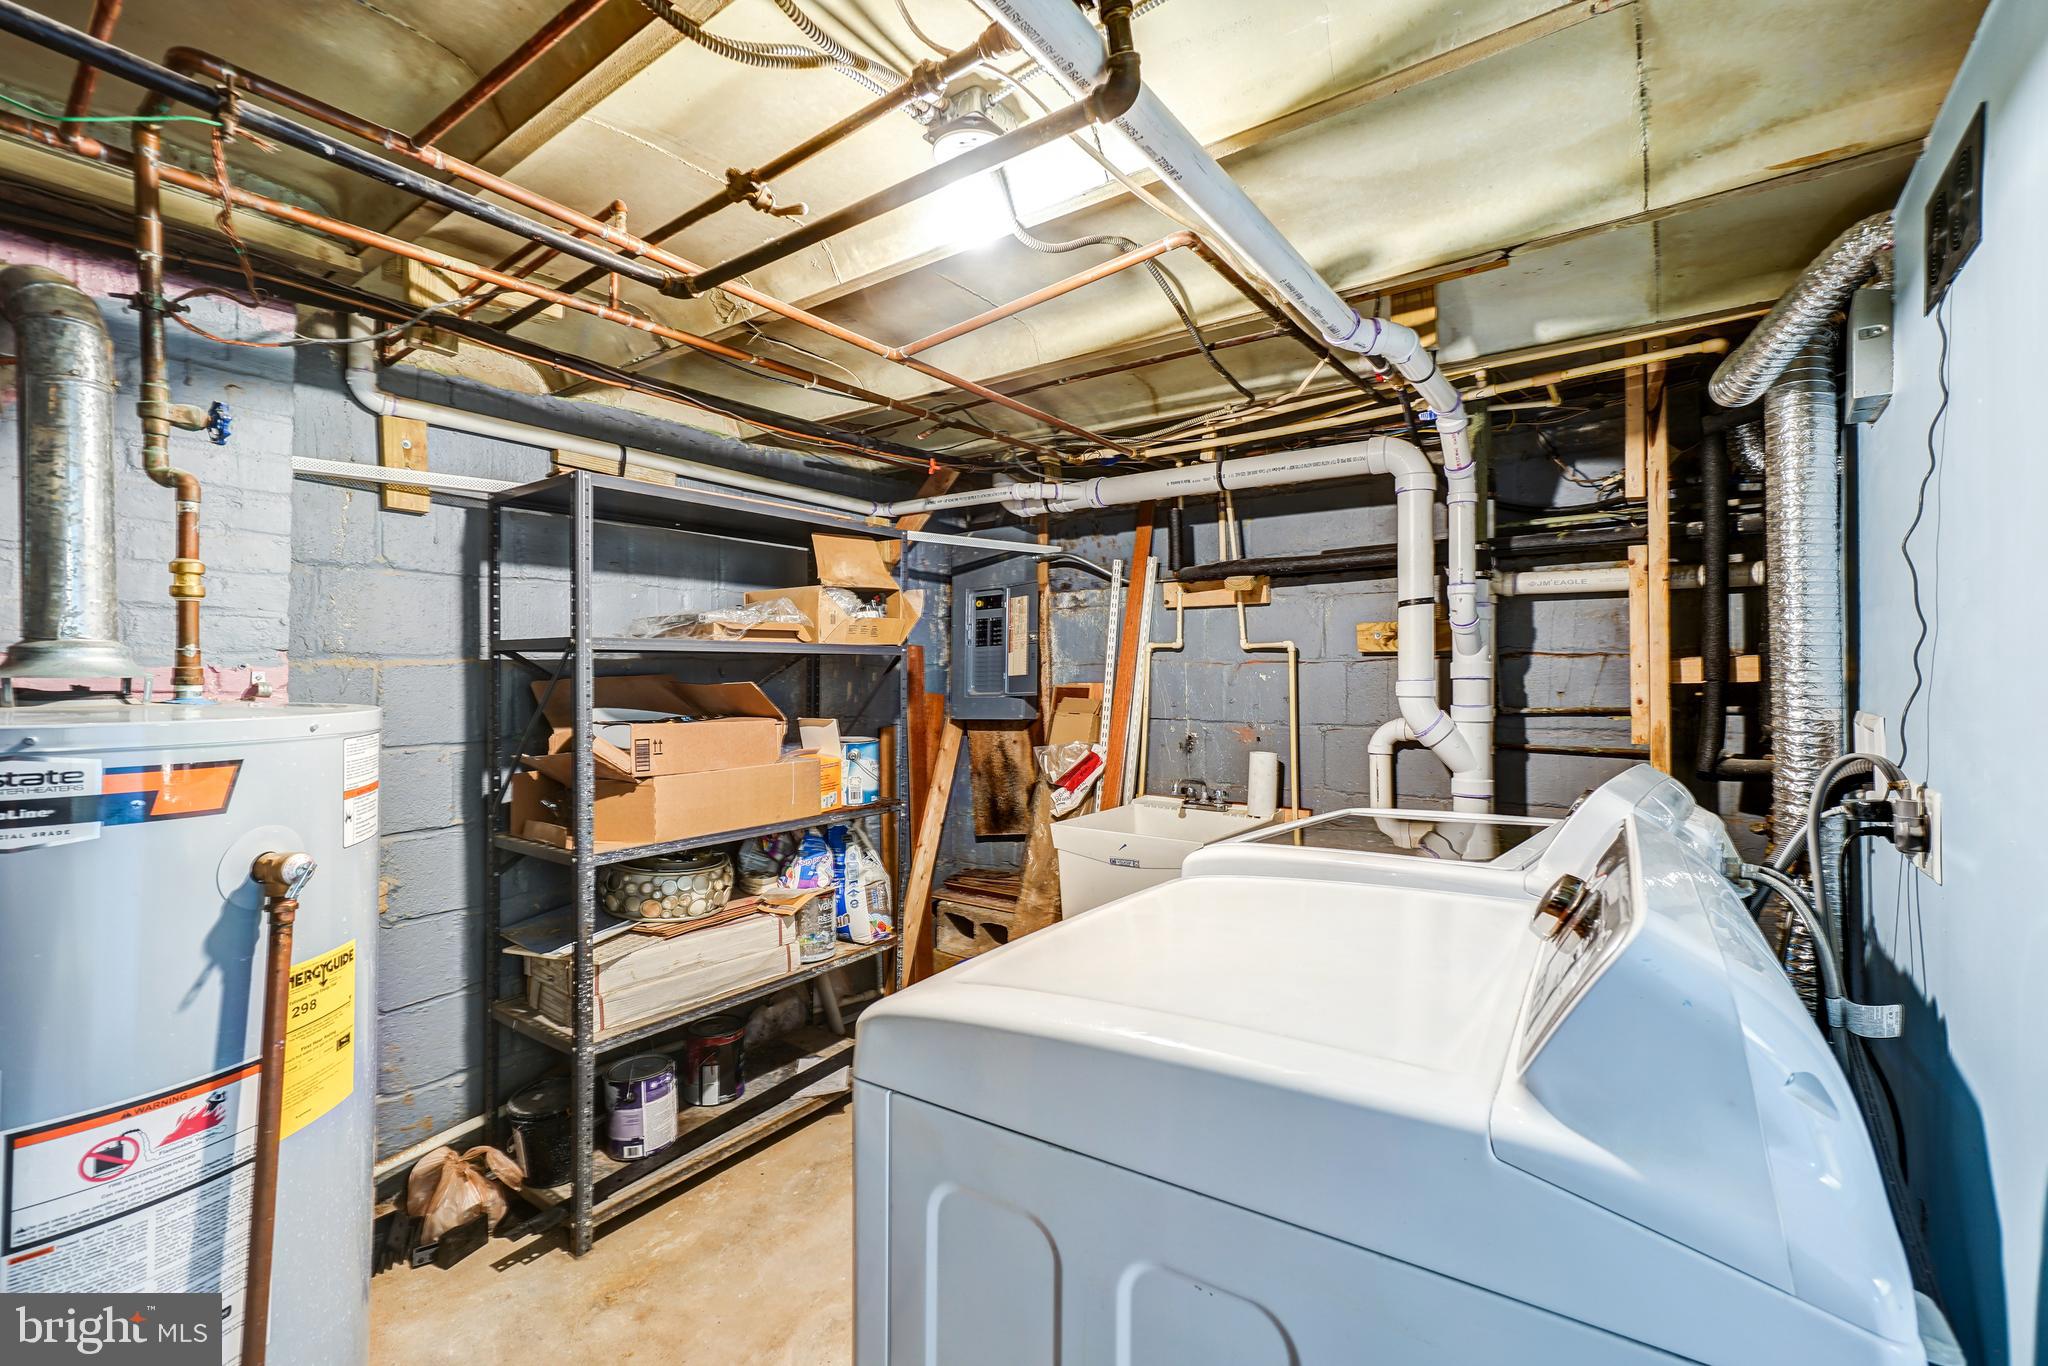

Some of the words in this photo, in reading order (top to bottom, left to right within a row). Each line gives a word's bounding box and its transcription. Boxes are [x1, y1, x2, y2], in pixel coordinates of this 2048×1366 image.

[1554, 578, 1588, 586] EAGLE
[0, 770, 84, 788] tate
[0, 788, 25, 796] TER
[27, 784, 85, 794] HEATERS
[31, 829, 71, 838] GRADE
[288, 948, 354, 989] NERGYGUIDE
[291, 999, 317, 1018] 298
[134, 1092, 188, 1114] WARNING
